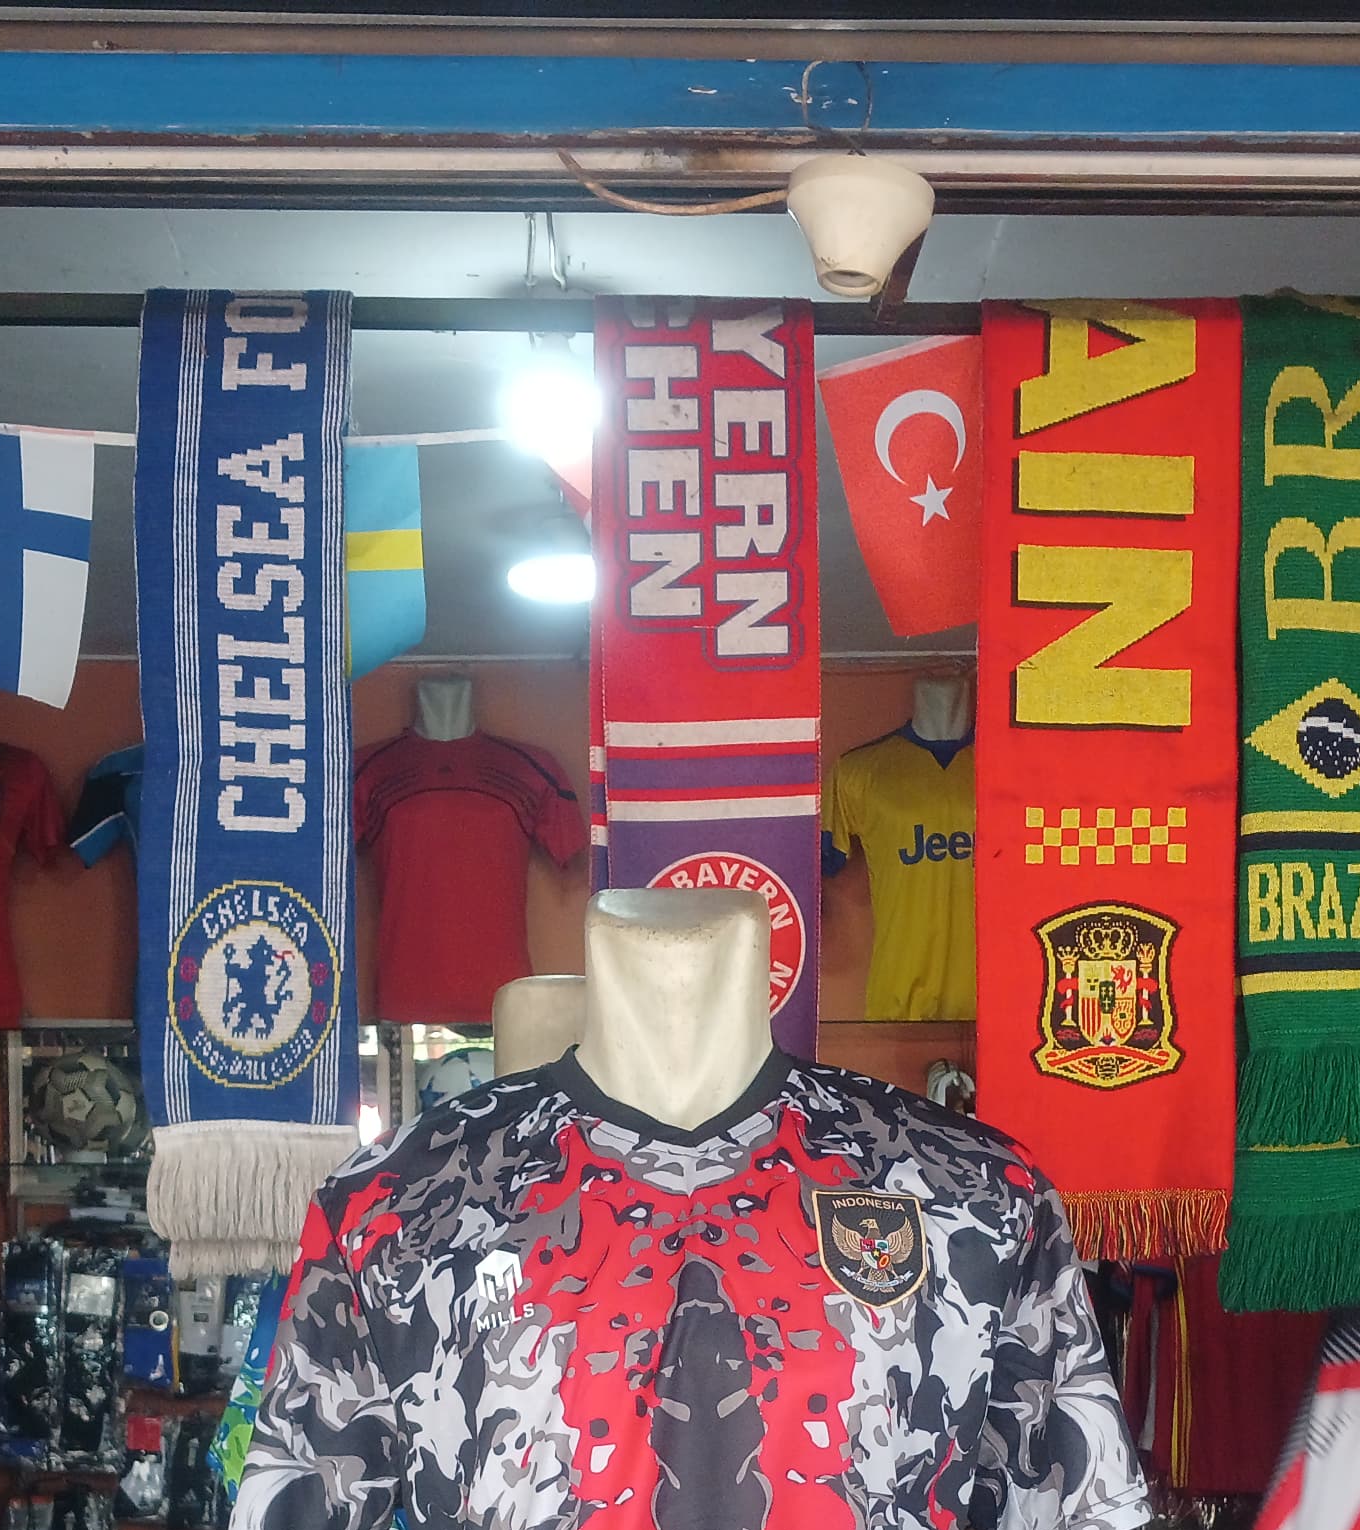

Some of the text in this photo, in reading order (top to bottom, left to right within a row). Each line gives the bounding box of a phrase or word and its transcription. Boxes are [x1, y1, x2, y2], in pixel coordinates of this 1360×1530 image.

[216, 432, 307, 833] CHELSEA
[898, 823, 976, 867] Jee
[202, 888, 308, 947] CHELSEA
[831, 1196, 906, 1213] INDONESIA
